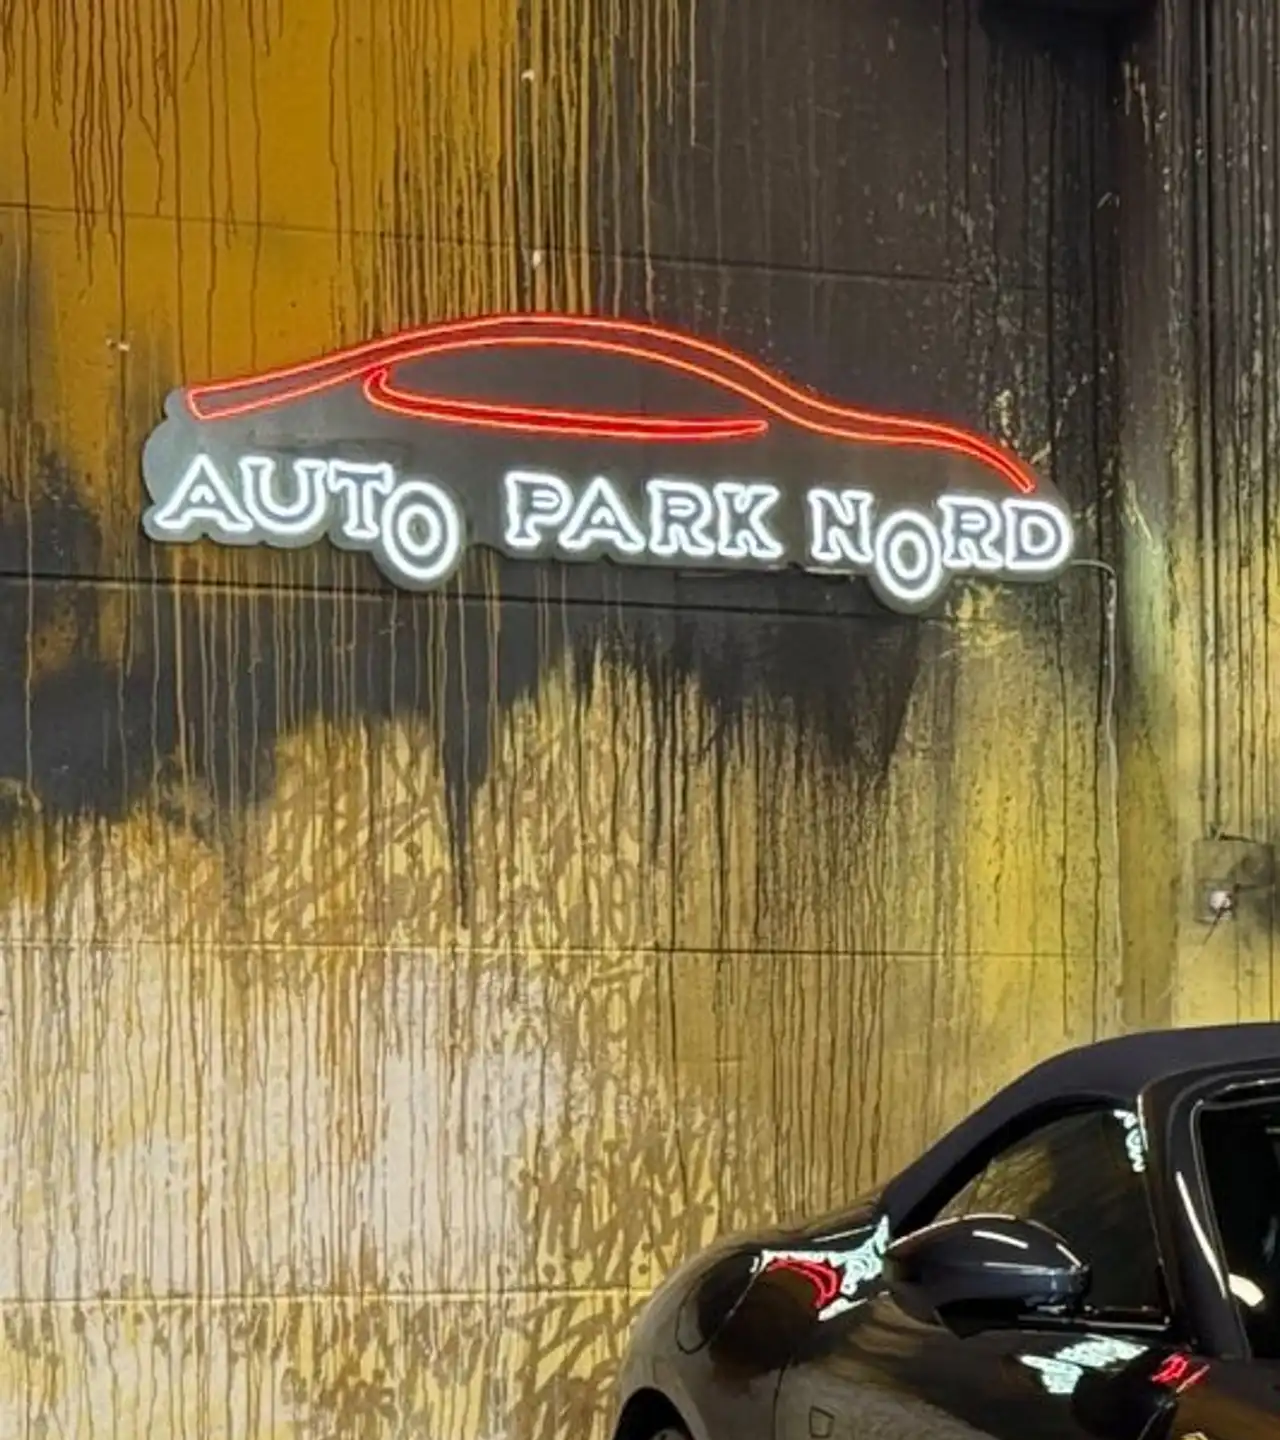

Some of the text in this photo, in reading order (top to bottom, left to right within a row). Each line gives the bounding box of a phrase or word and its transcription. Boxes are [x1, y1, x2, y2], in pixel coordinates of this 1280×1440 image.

[153, 454, 1074, 602] AUTO PARK NORD
